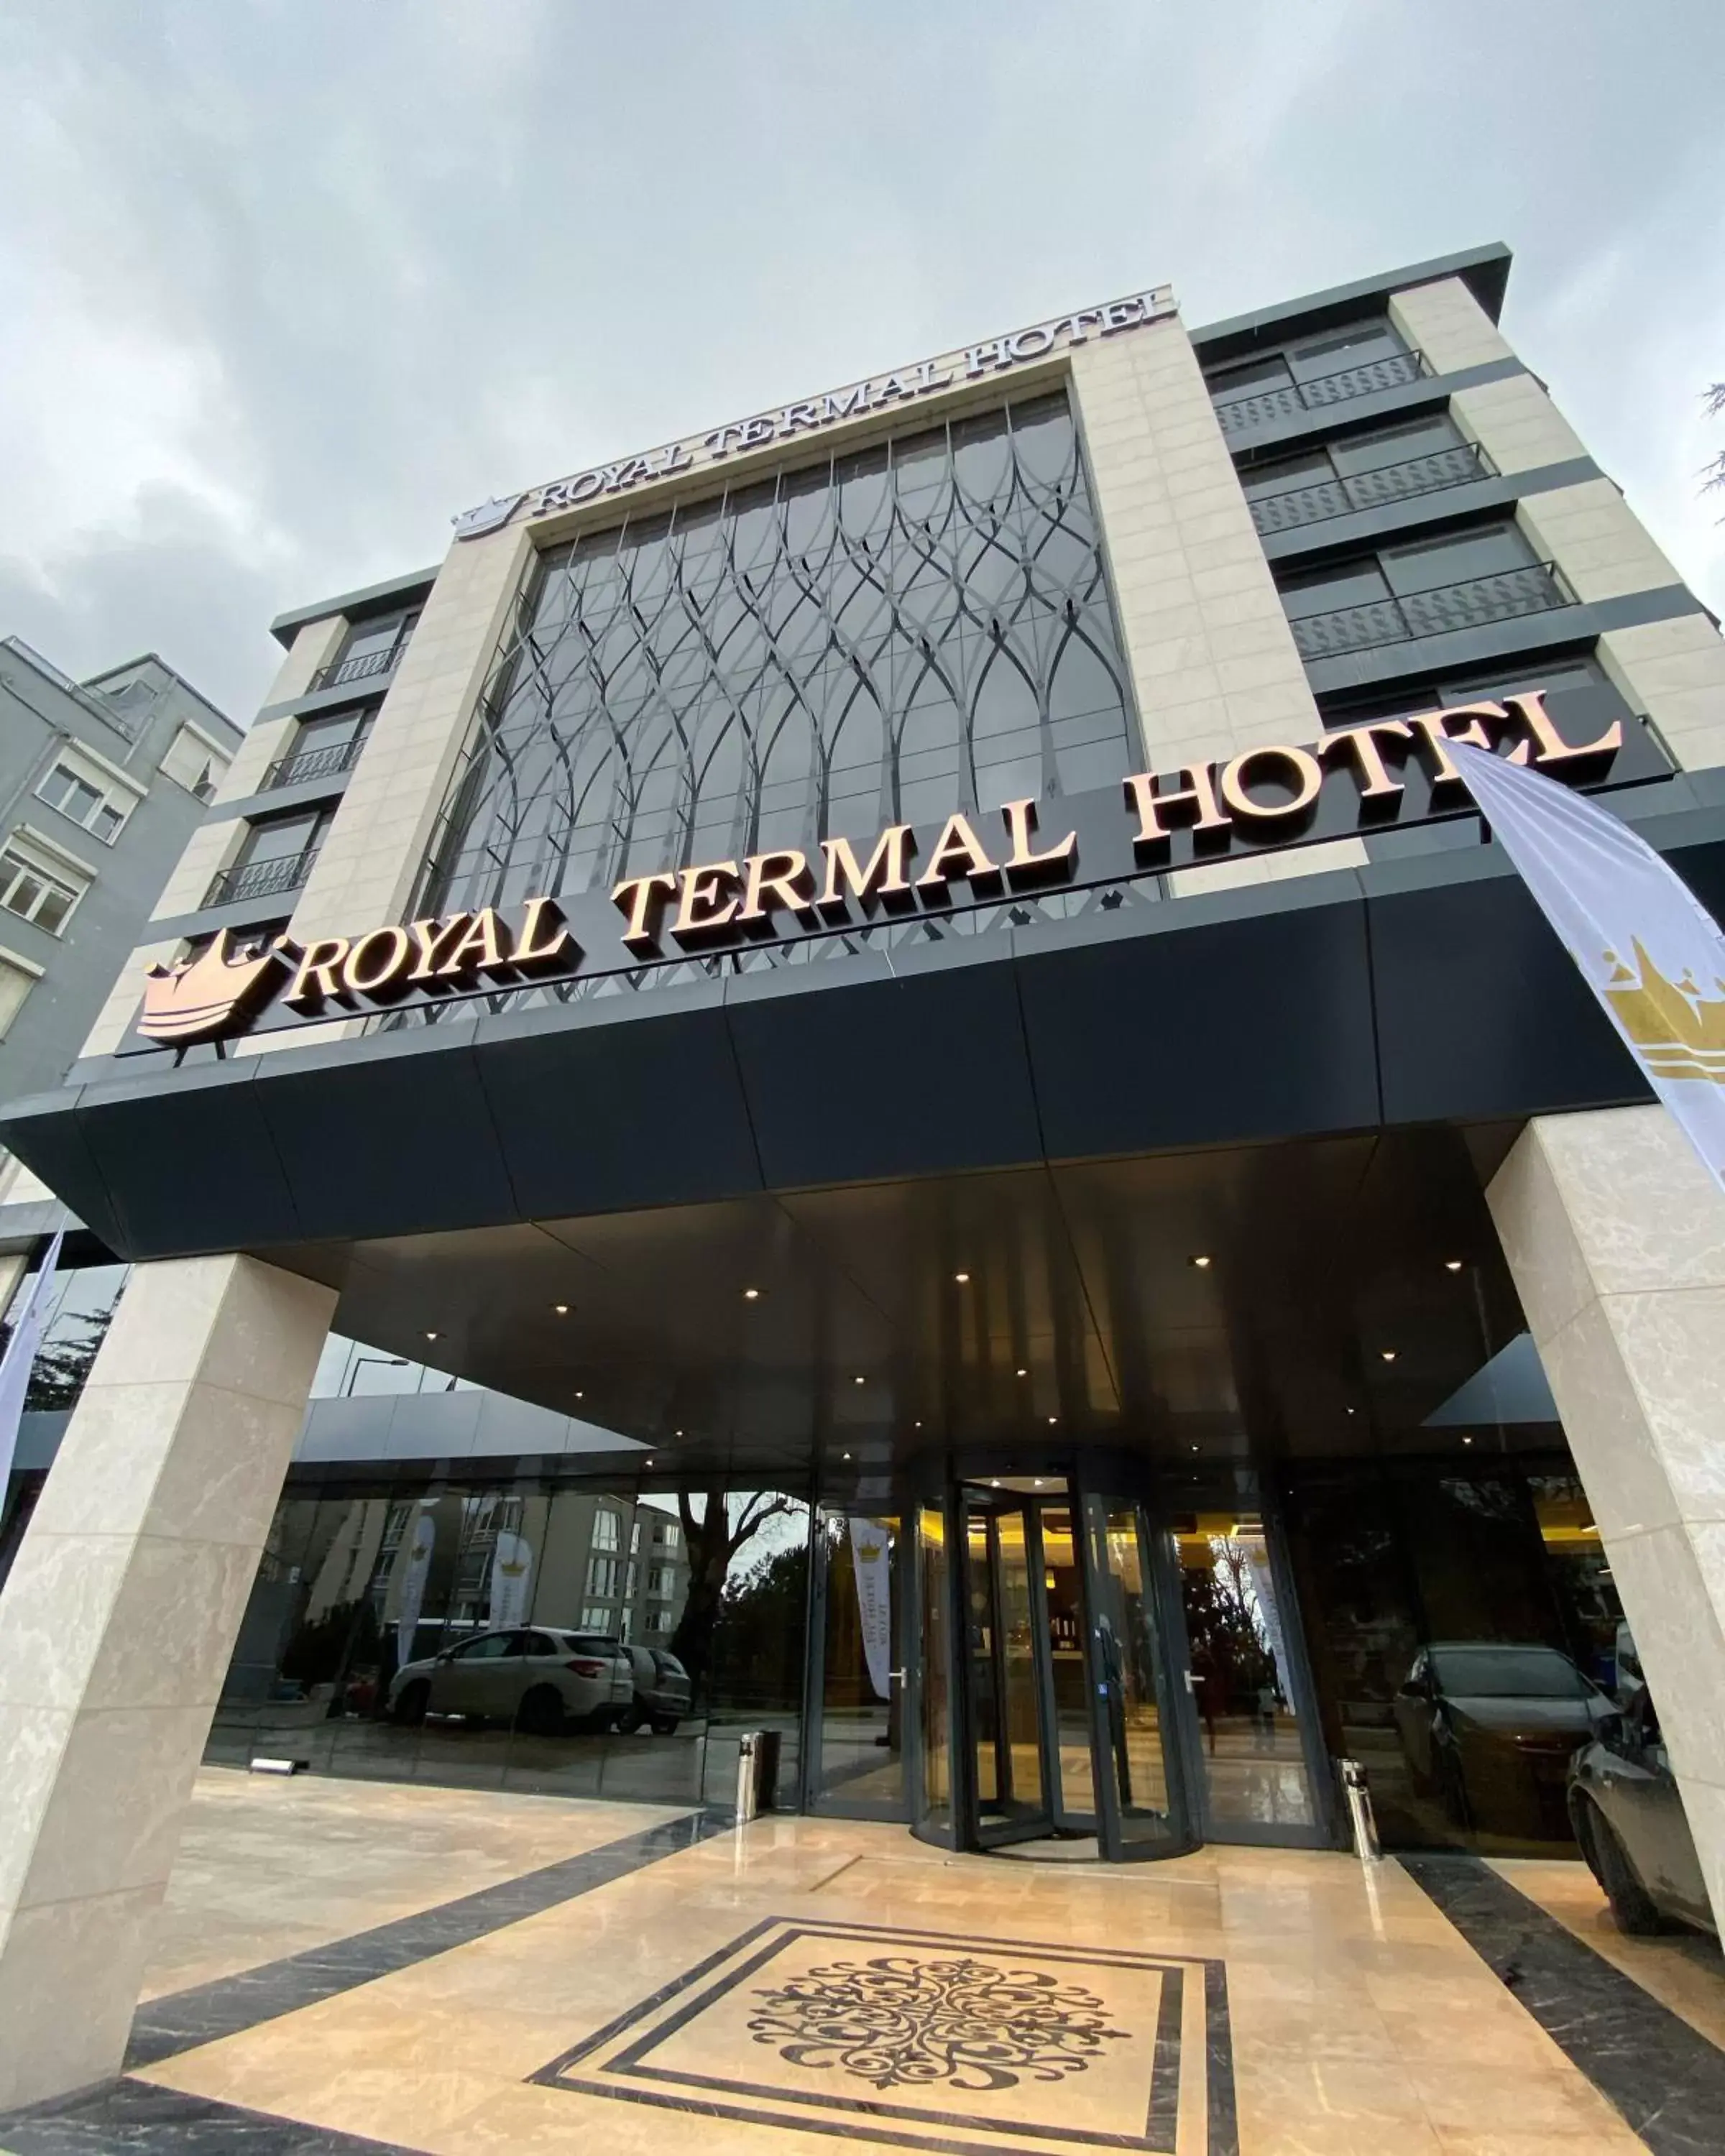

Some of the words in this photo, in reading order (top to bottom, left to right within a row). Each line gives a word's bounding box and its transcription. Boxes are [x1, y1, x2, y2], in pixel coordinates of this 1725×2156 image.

[533, 446, 694, 515] ROYAL
[704, 363, 953, 459] TERMAL
[965, 293, 1177, 379] HOTEL
[282, 897, 570, 1004] ROYAL
[610, 798, 1077, 941] TERMAL
[1123, 689, 1623, 842] HOTEL
